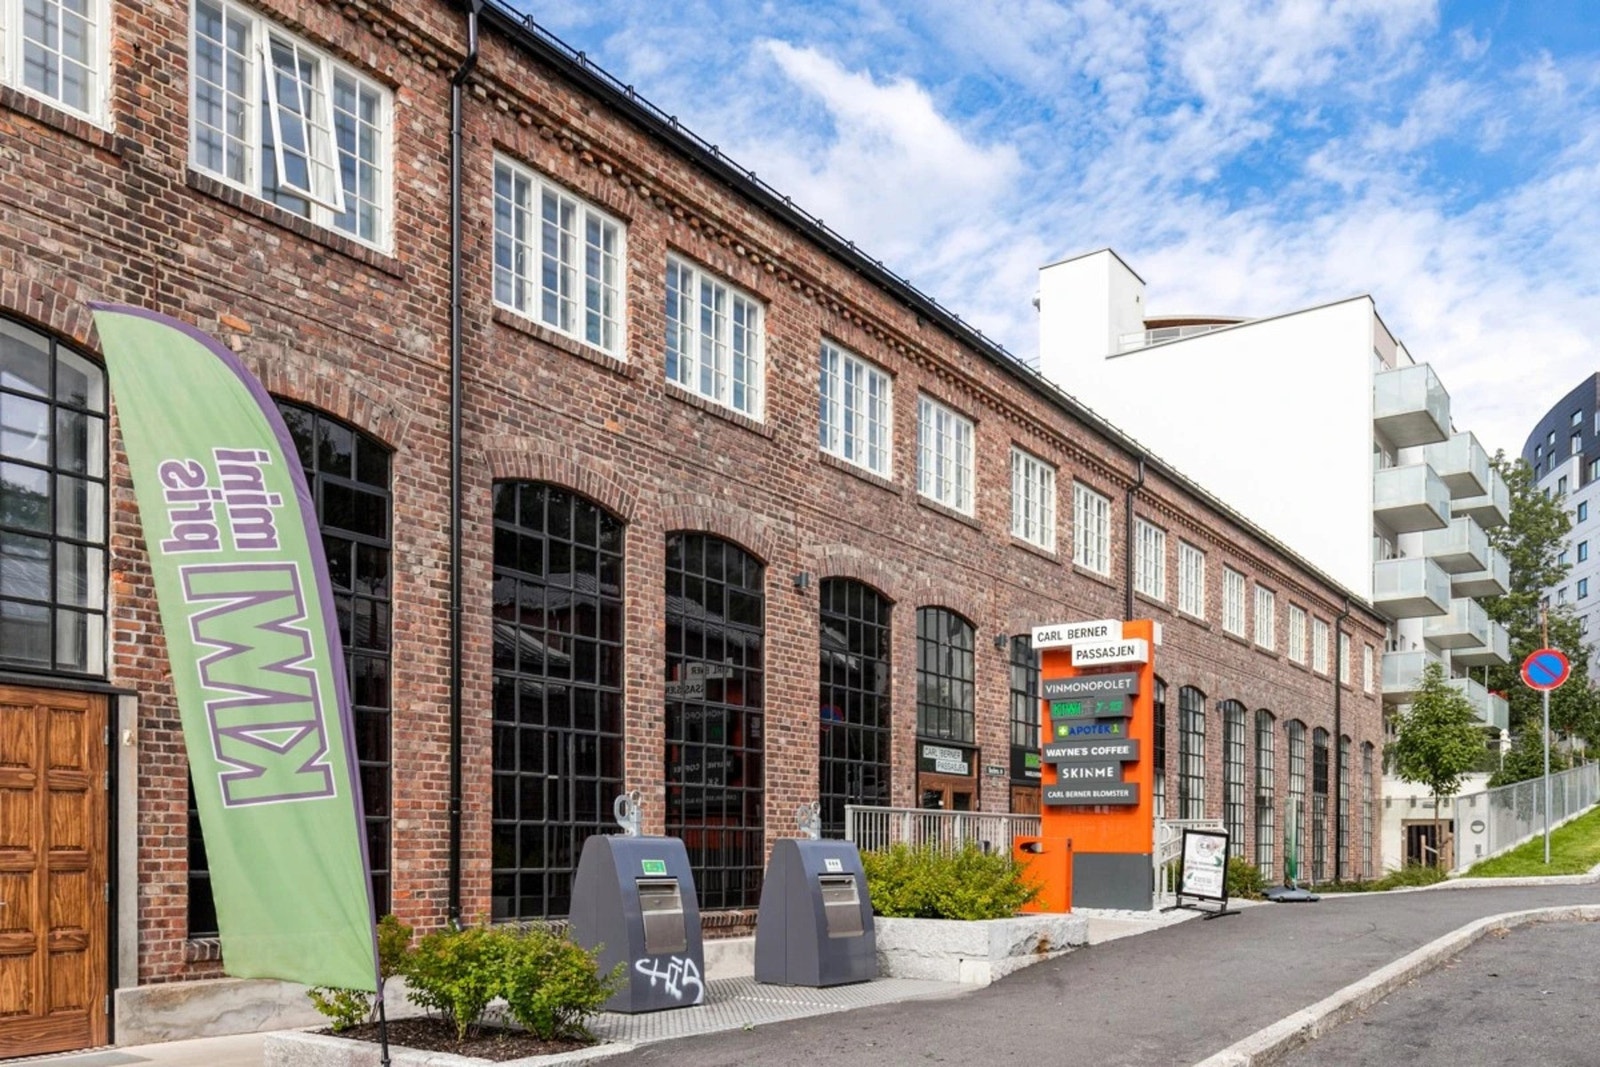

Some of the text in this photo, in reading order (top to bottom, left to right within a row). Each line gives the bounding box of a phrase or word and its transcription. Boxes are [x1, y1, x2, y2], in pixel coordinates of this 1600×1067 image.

[1037, 626, 1108, 642] CARL BERNER
[1076, 645, 1135, 660] PASSASJEN
[1045, 678, 1132, 693] VINMONOPOLET
[1069, 725, 1111, 736] APOTEK
[1091, 745, 1130, 756] COFFEE
[1062, 766, 1114, 779] SKINME
[1047, 789, 1129, 799] CARL BERNER BLOMSTER
